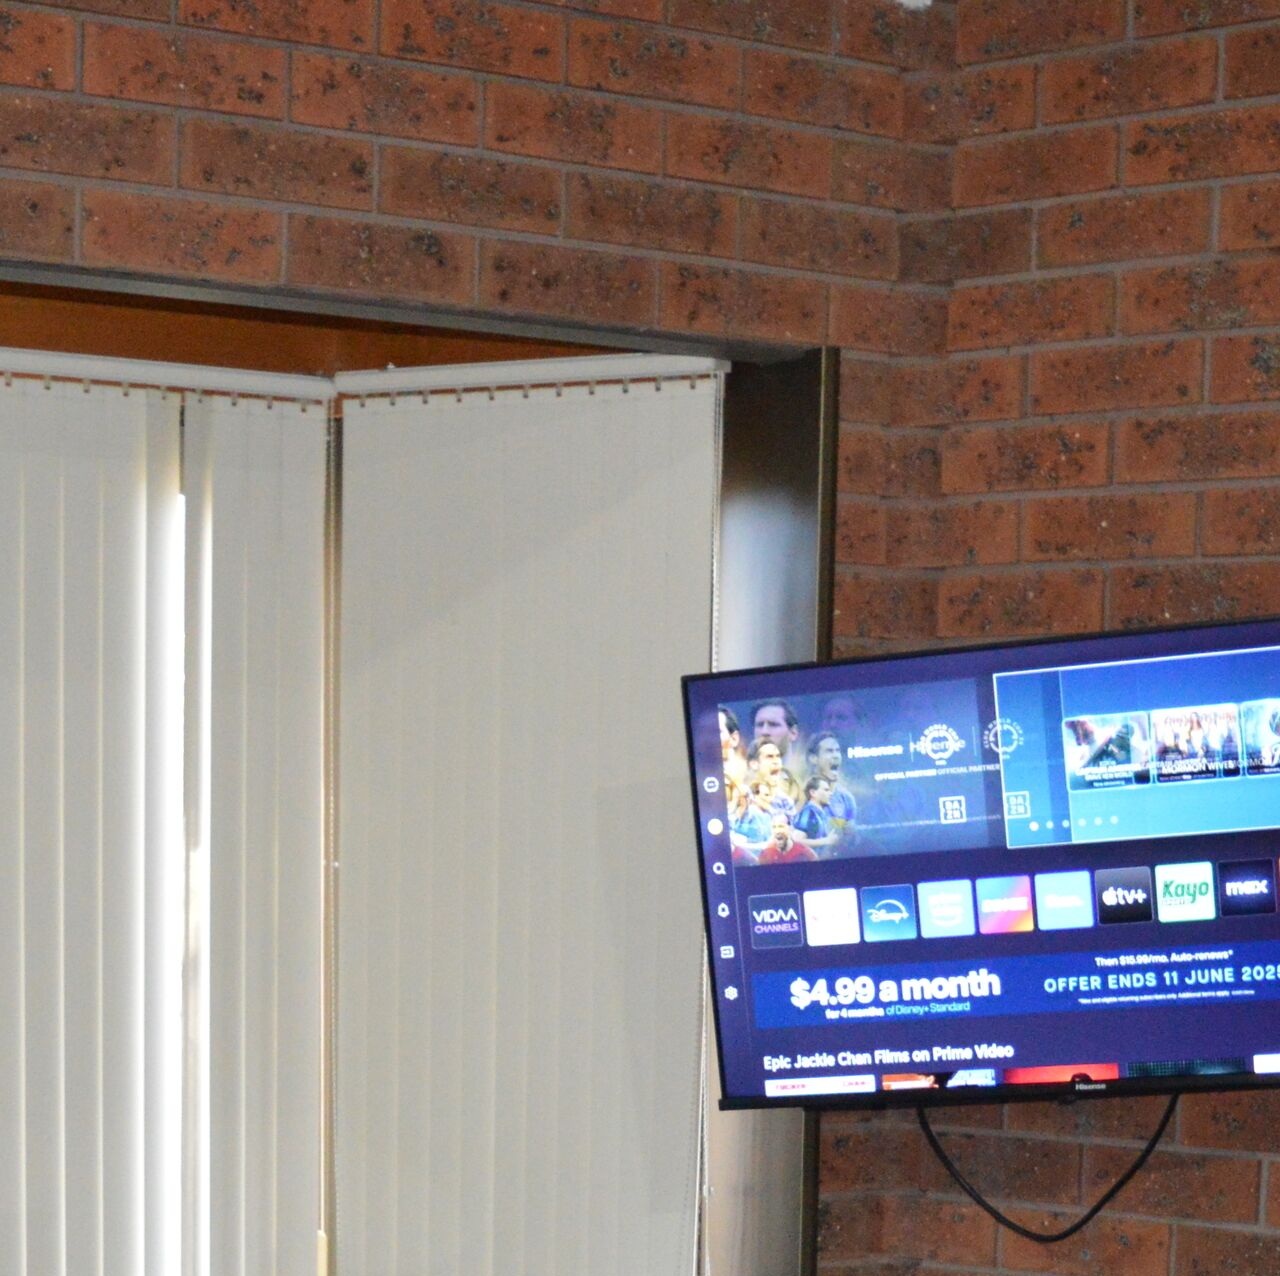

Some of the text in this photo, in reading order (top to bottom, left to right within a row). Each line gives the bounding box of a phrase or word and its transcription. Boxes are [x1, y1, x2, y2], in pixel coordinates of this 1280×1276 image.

[1162, 880, 1209, 904] Kayo
[1225, 880, 1269, 897] max
[754, 923, 799, 934] CHANNELS
[1094, 956, 1118, 967] Then
[1043, 975, 1102, 993] OFFER
[1107, 972, 1157, 989] ENDS
[1163, 970, 1179, 986] 11
[1184, 967, 1235, 985] JUNE
[789, 968, 1001, 1010] $4.99 a month
[929, 1001, 971, 1013] Standard
[763, 1043, 1015, 1073] Epic Jackie Chan Films on Prime Video
[1075, 1083, 1106, 1091] Hisense
